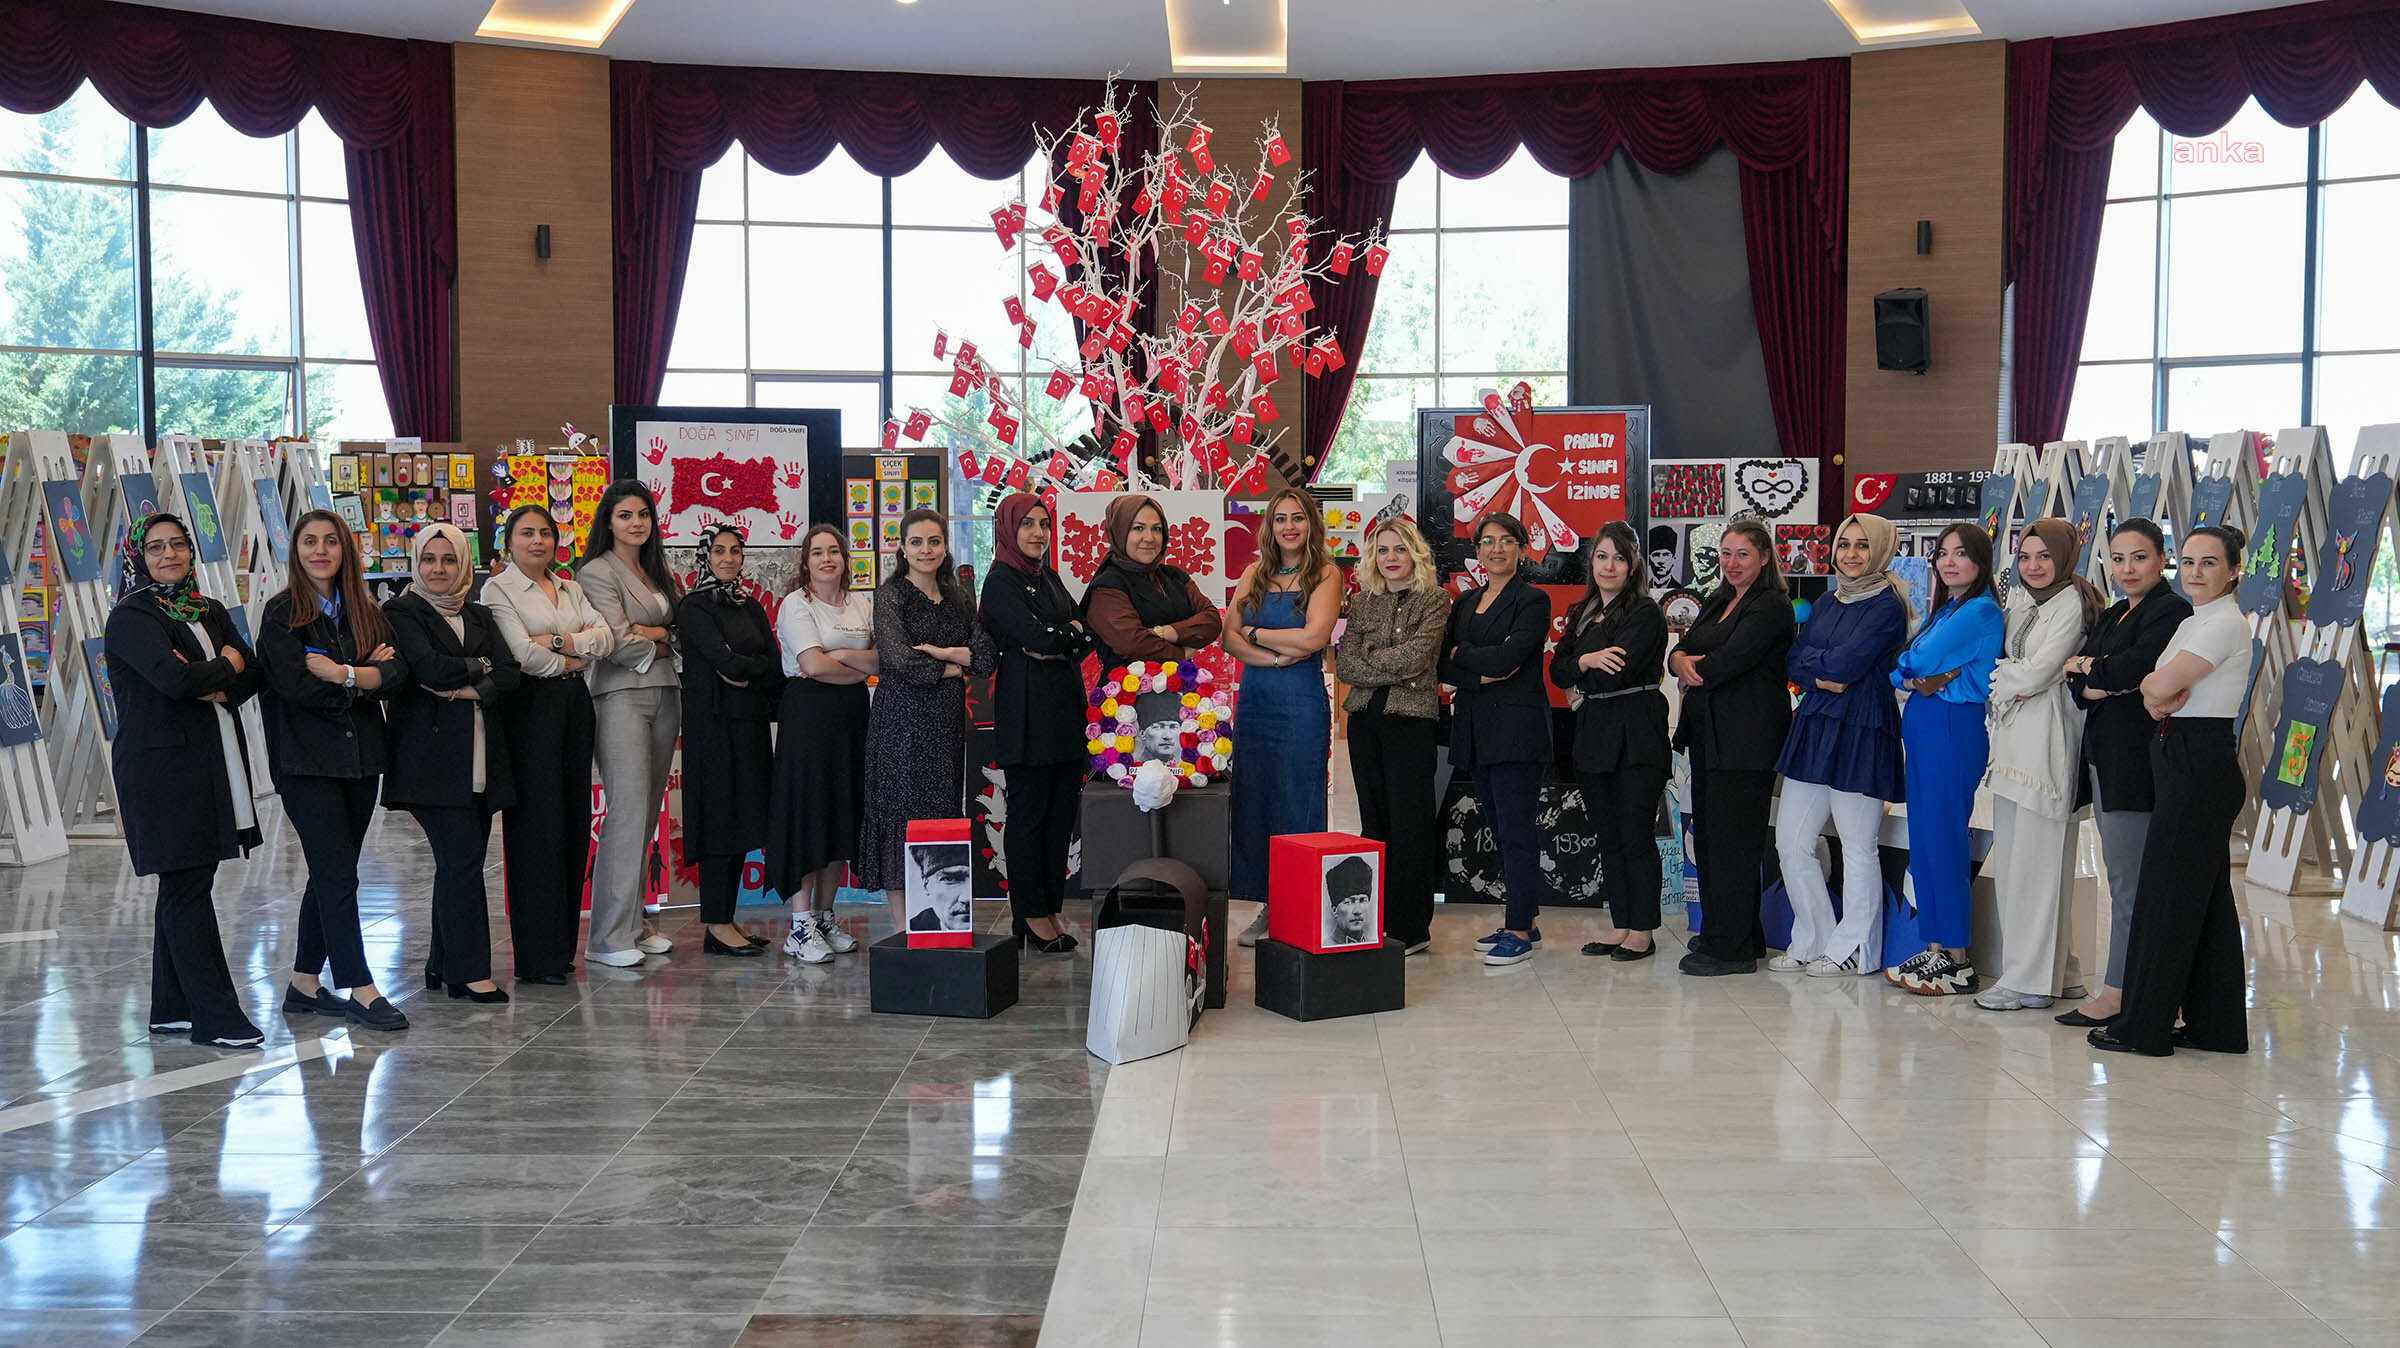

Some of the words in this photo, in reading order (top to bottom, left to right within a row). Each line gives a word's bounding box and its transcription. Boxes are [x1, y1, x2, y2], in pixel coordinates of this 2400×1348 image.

[679, 426, 717, 440] DOĞA
[725, 428, 760, 442] SINIFI
[1563, 432, 1615, 451] PARILTI
[882, 459, 902, 468] ÇİÇEK
[1578, 459, 1618, 475] SINIFI
[1924, 472, 1953, 484] 1881
[1968, 470, 1992, 483] 193
[1567, 480, 1620, 500] İZİNDE
[2289, 732, 2310, 777] 5
